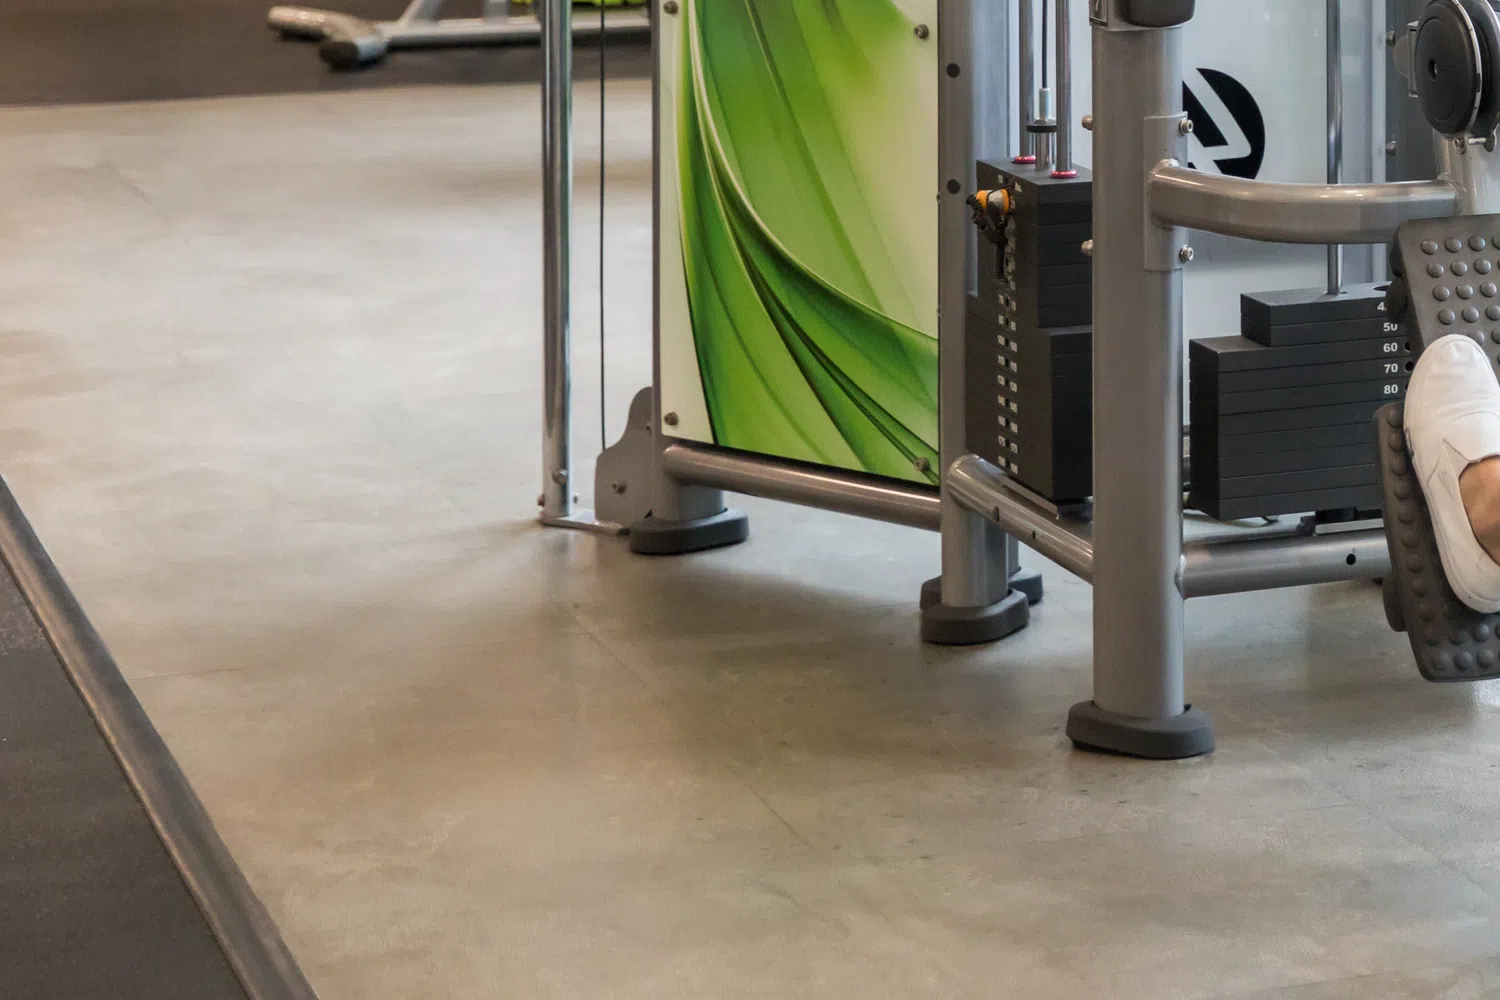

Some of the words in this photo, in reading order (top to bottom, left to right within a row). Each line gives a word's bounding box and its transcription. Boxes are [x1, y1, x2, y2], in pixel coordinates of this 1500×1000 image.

[1383, 343, 1398, 353] 60
[1384, 363, 1399, 374] 70
[1383, 384, 1399, 395] 80
